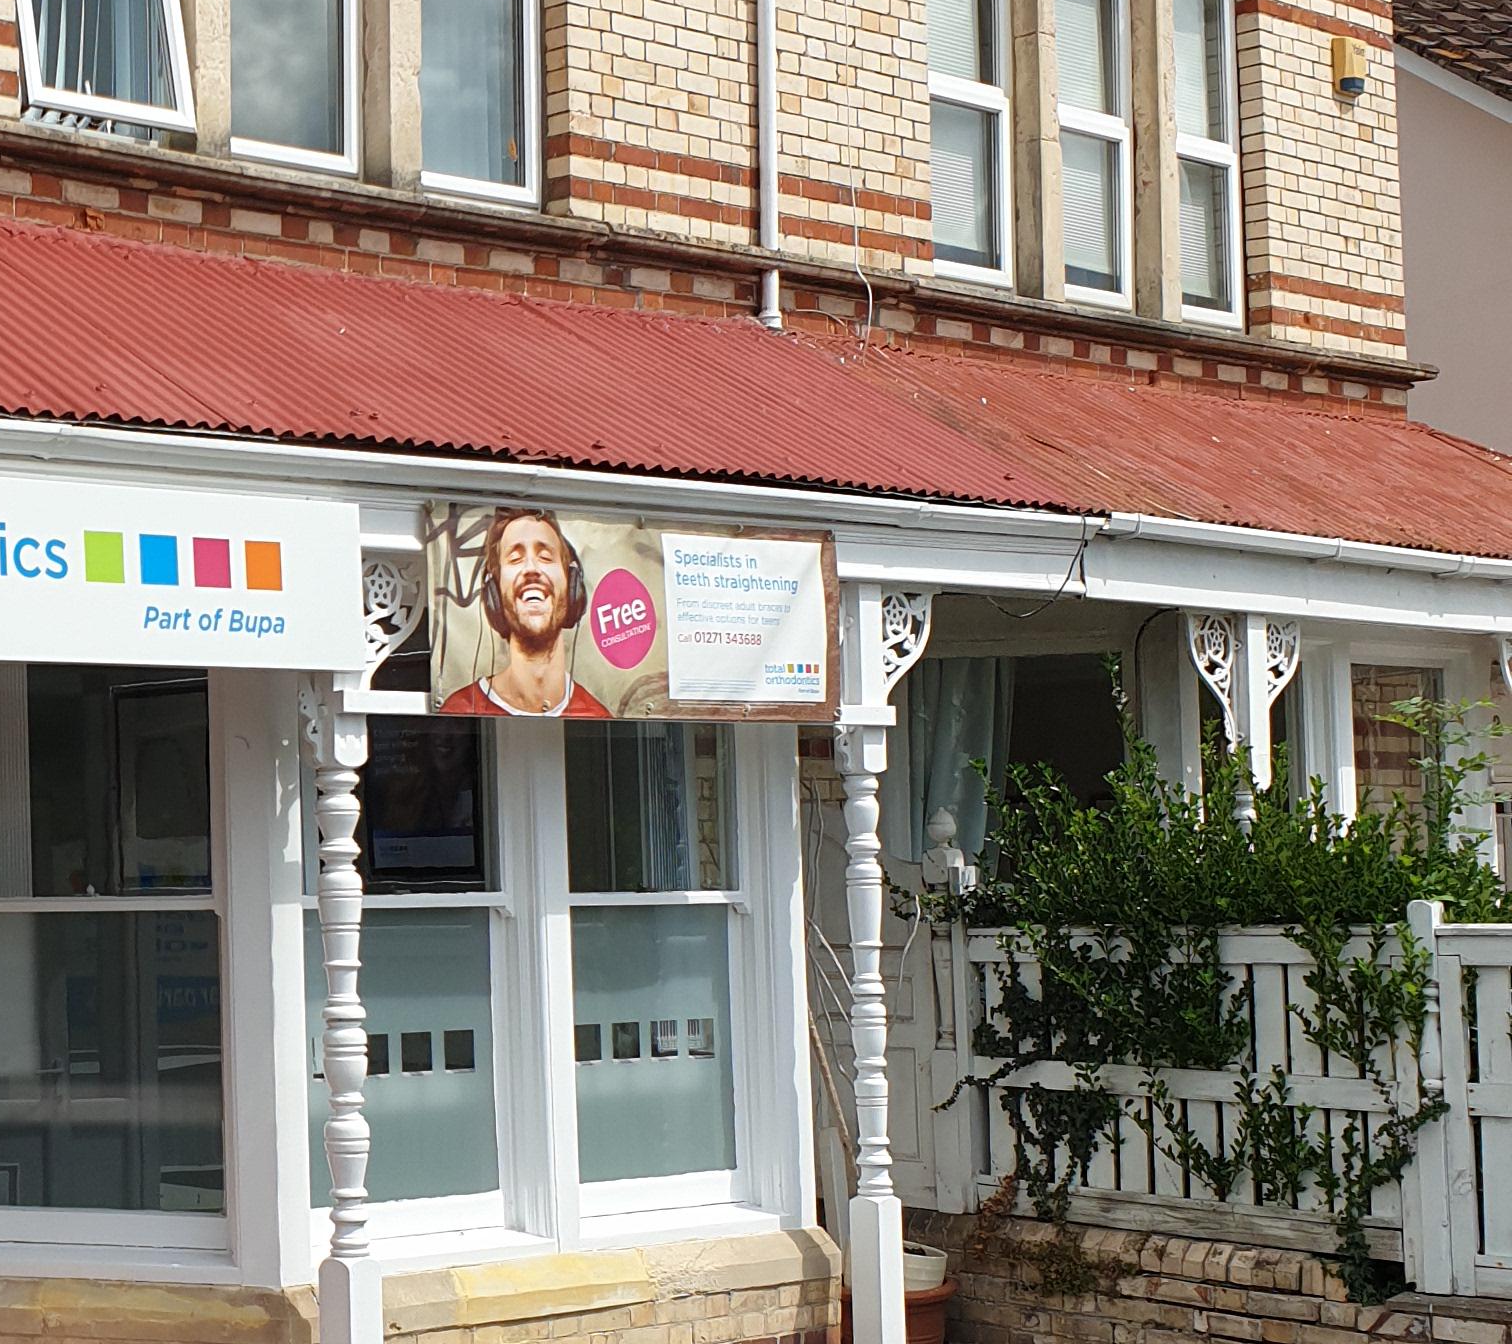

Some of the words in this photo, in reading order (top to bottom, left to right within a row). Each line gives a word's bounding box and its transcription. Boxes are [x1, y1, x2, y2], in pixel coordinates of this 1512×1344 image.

[674, 549, 742, 568] Specialists
[745, 554, 758, 569] in
[675, 571, 710, 587] teeth
[714, 574, 799, 595] straightening
[676, 597, 699, 608] From
[144, 606, 191, 630] Part
[198, 608, 223, 632] of
[228, 609, 285, 639] Bupa
[596, 598, 648, 635] Free
[677, 633, 692, 643] Call
[694, 631, 722, 644] 01271
[725, 632, 762, 646] 343688
[764, 663, 786, 674] total
[765, 674, 820, 686] orthodontics
